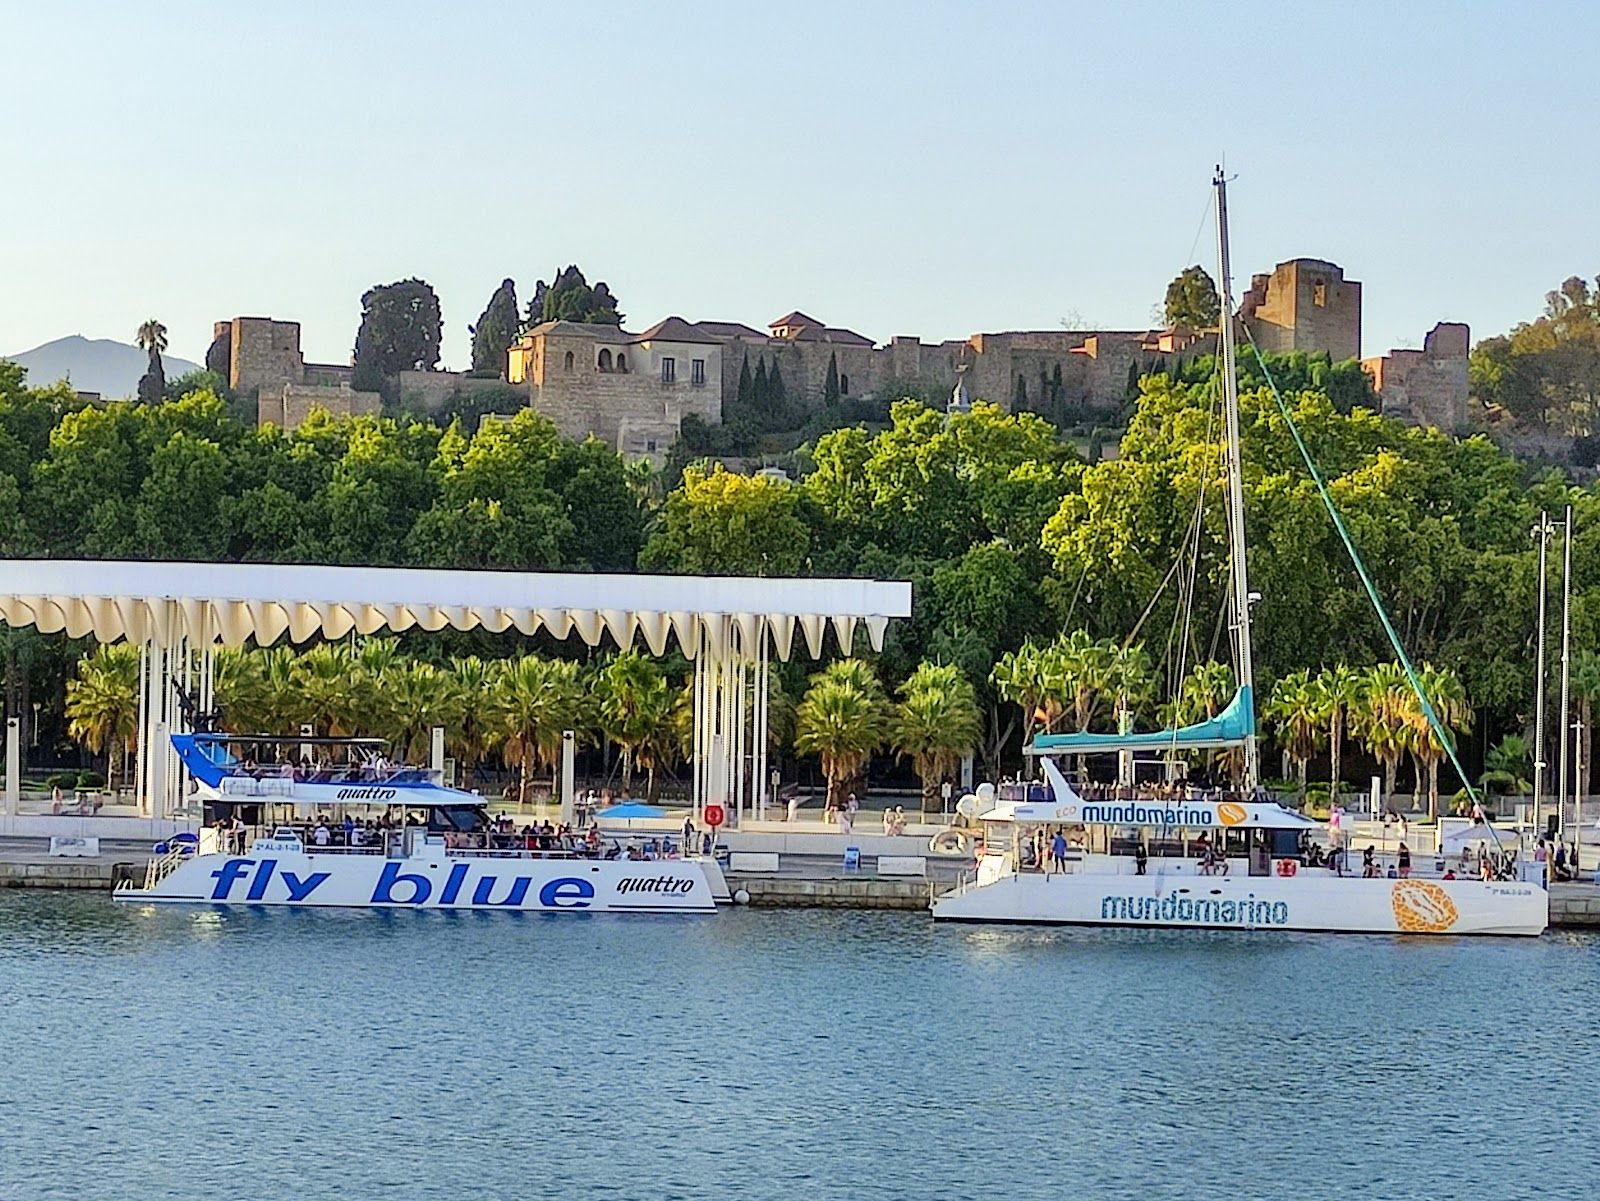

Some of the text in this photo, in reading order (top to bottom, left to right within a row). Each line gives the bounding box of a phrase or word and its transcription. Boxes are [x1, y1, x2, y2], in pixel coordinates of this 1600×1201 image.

[337, 786, 396, 800] quattro
[1056, 803, 1212, 824] ECO mundomarino
[211, 859, 595, 907] fly blue
[616, 876, 694, 894] quattro
[1101, 890, 1288, 924] mundomarino
